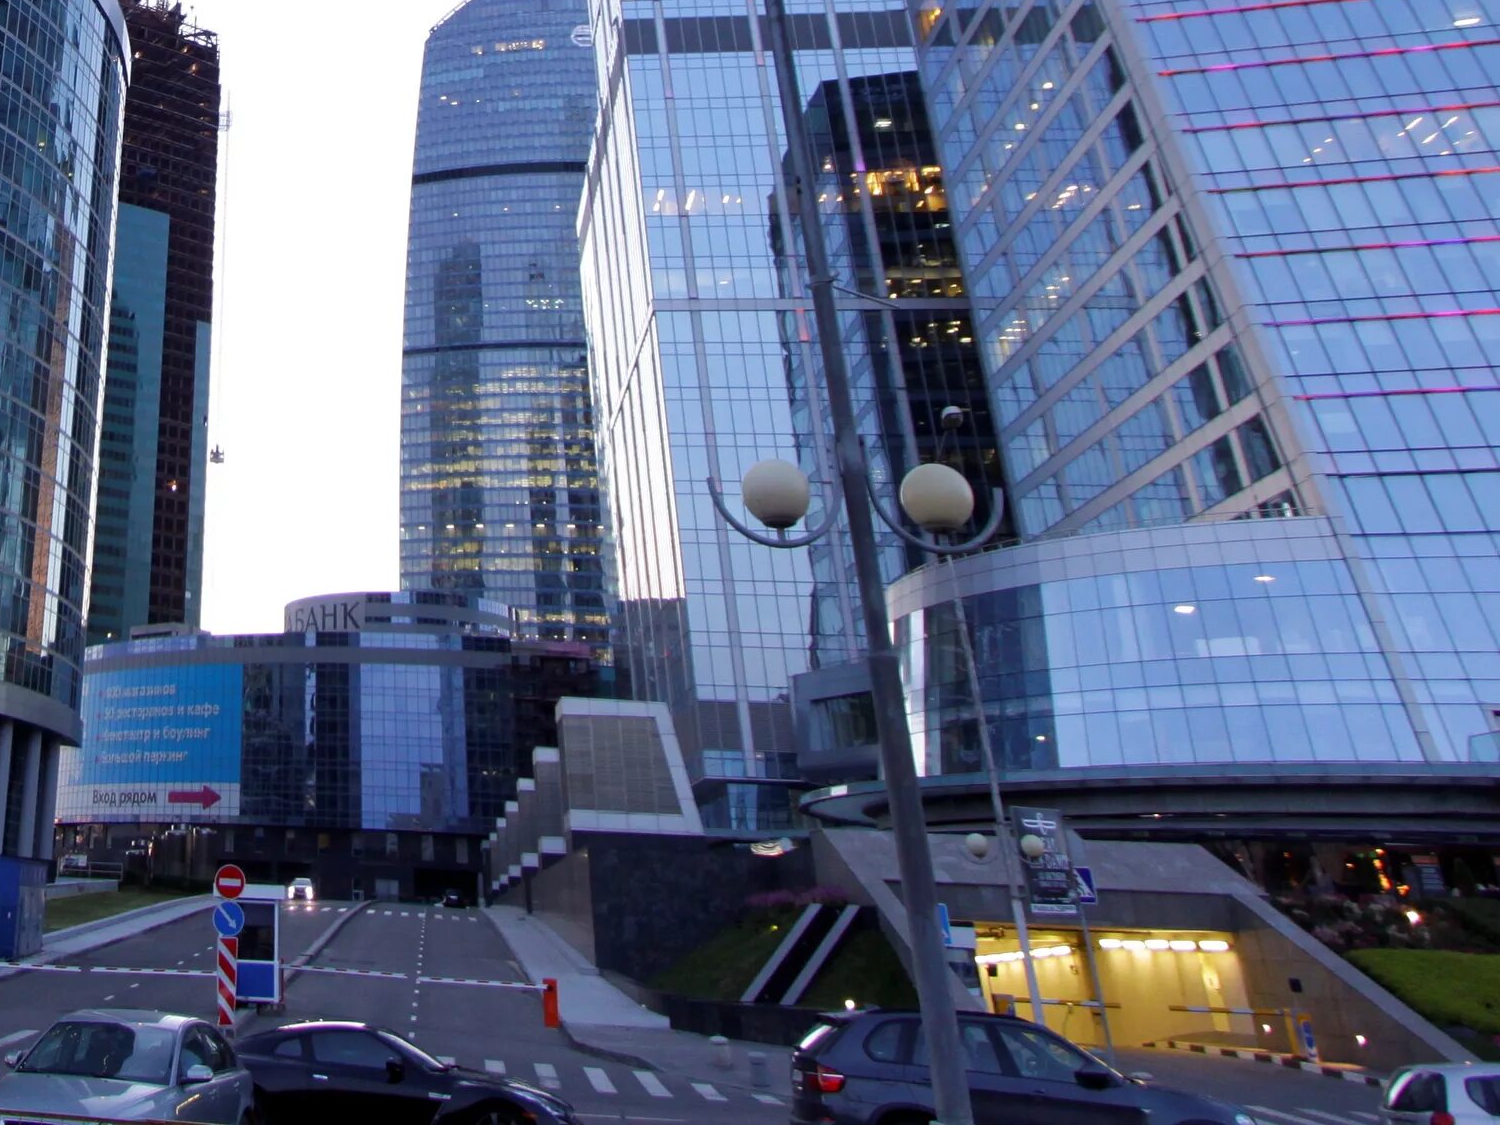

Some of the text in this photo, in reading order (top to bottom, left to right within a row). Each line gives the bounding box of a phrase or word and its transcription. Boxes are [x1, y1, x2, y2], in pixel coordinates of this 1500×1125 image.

[187, 702, 220, 719] кафе
[162, 726, 211, 742] боулинг
[143, 751, 188, 765] паркинг
[93, 790, 157, 808] Вход рядом
